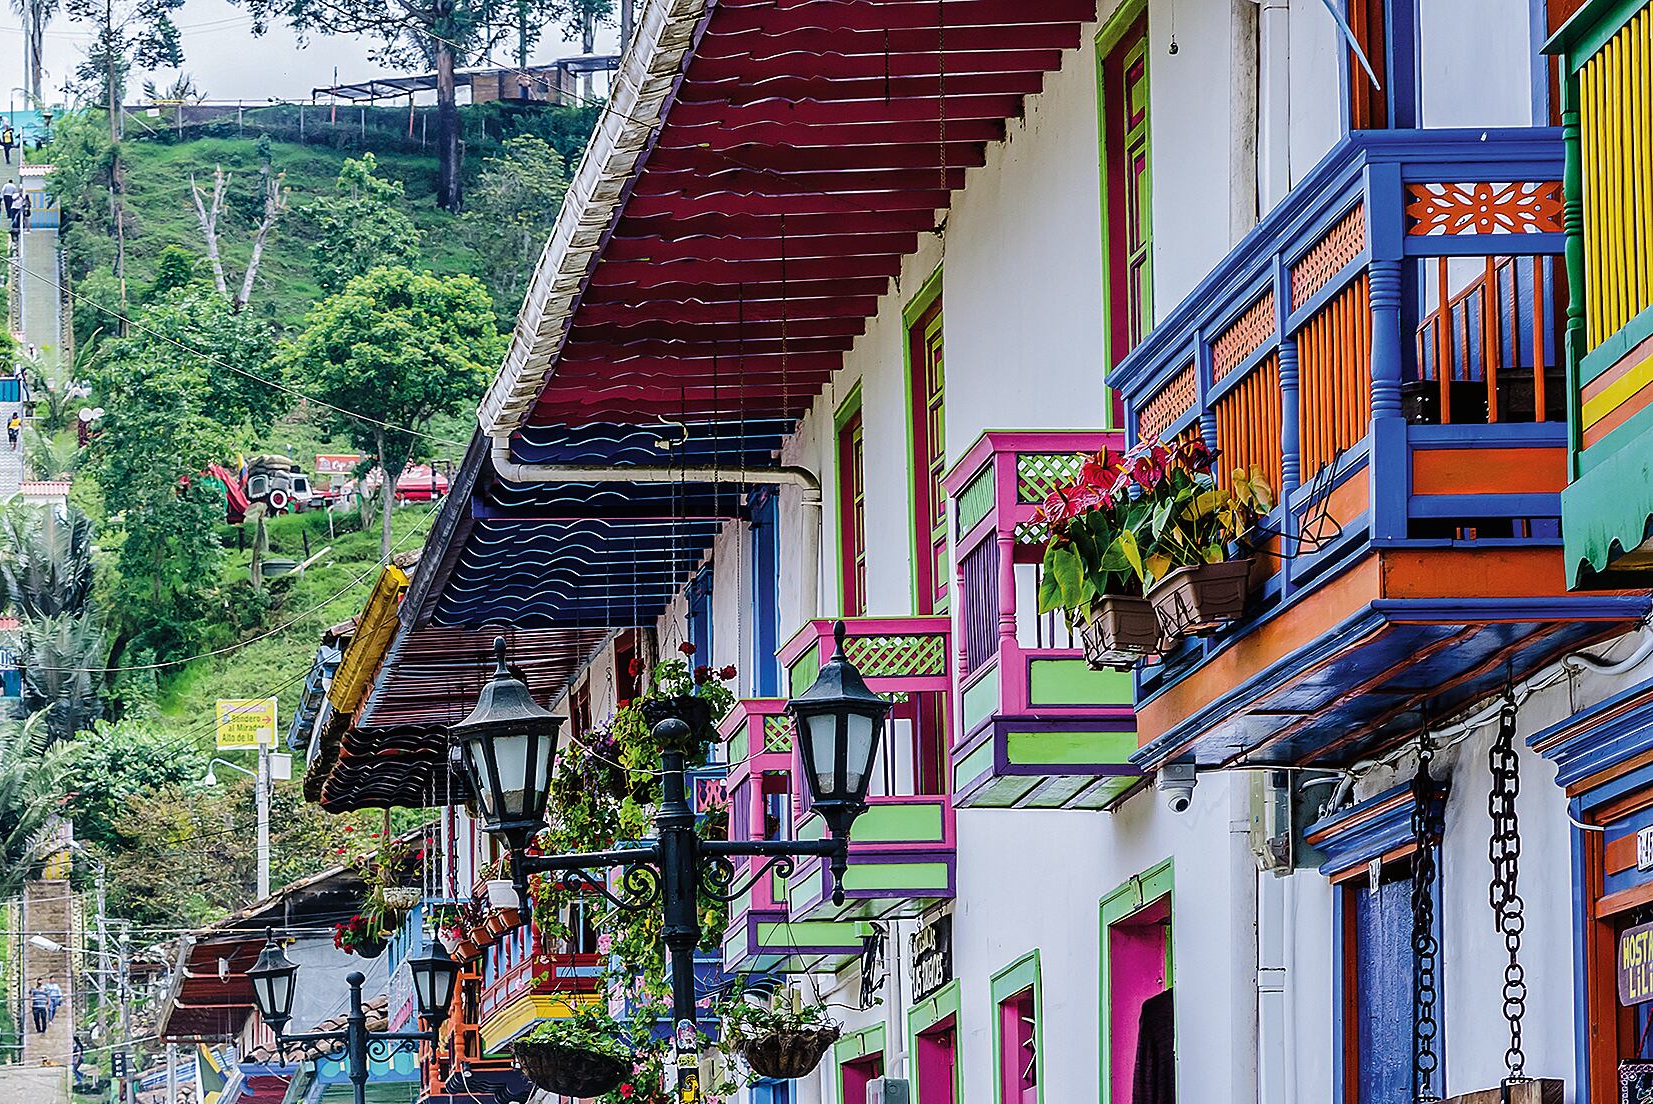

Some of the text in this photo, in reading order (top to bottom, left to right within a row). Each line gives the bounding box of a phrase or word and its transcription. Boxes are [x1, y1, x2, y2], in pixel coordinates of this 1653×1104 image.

[222, 733, 254, 742] Alto de la
[1623, 930, 1653, 970] HOSTA
